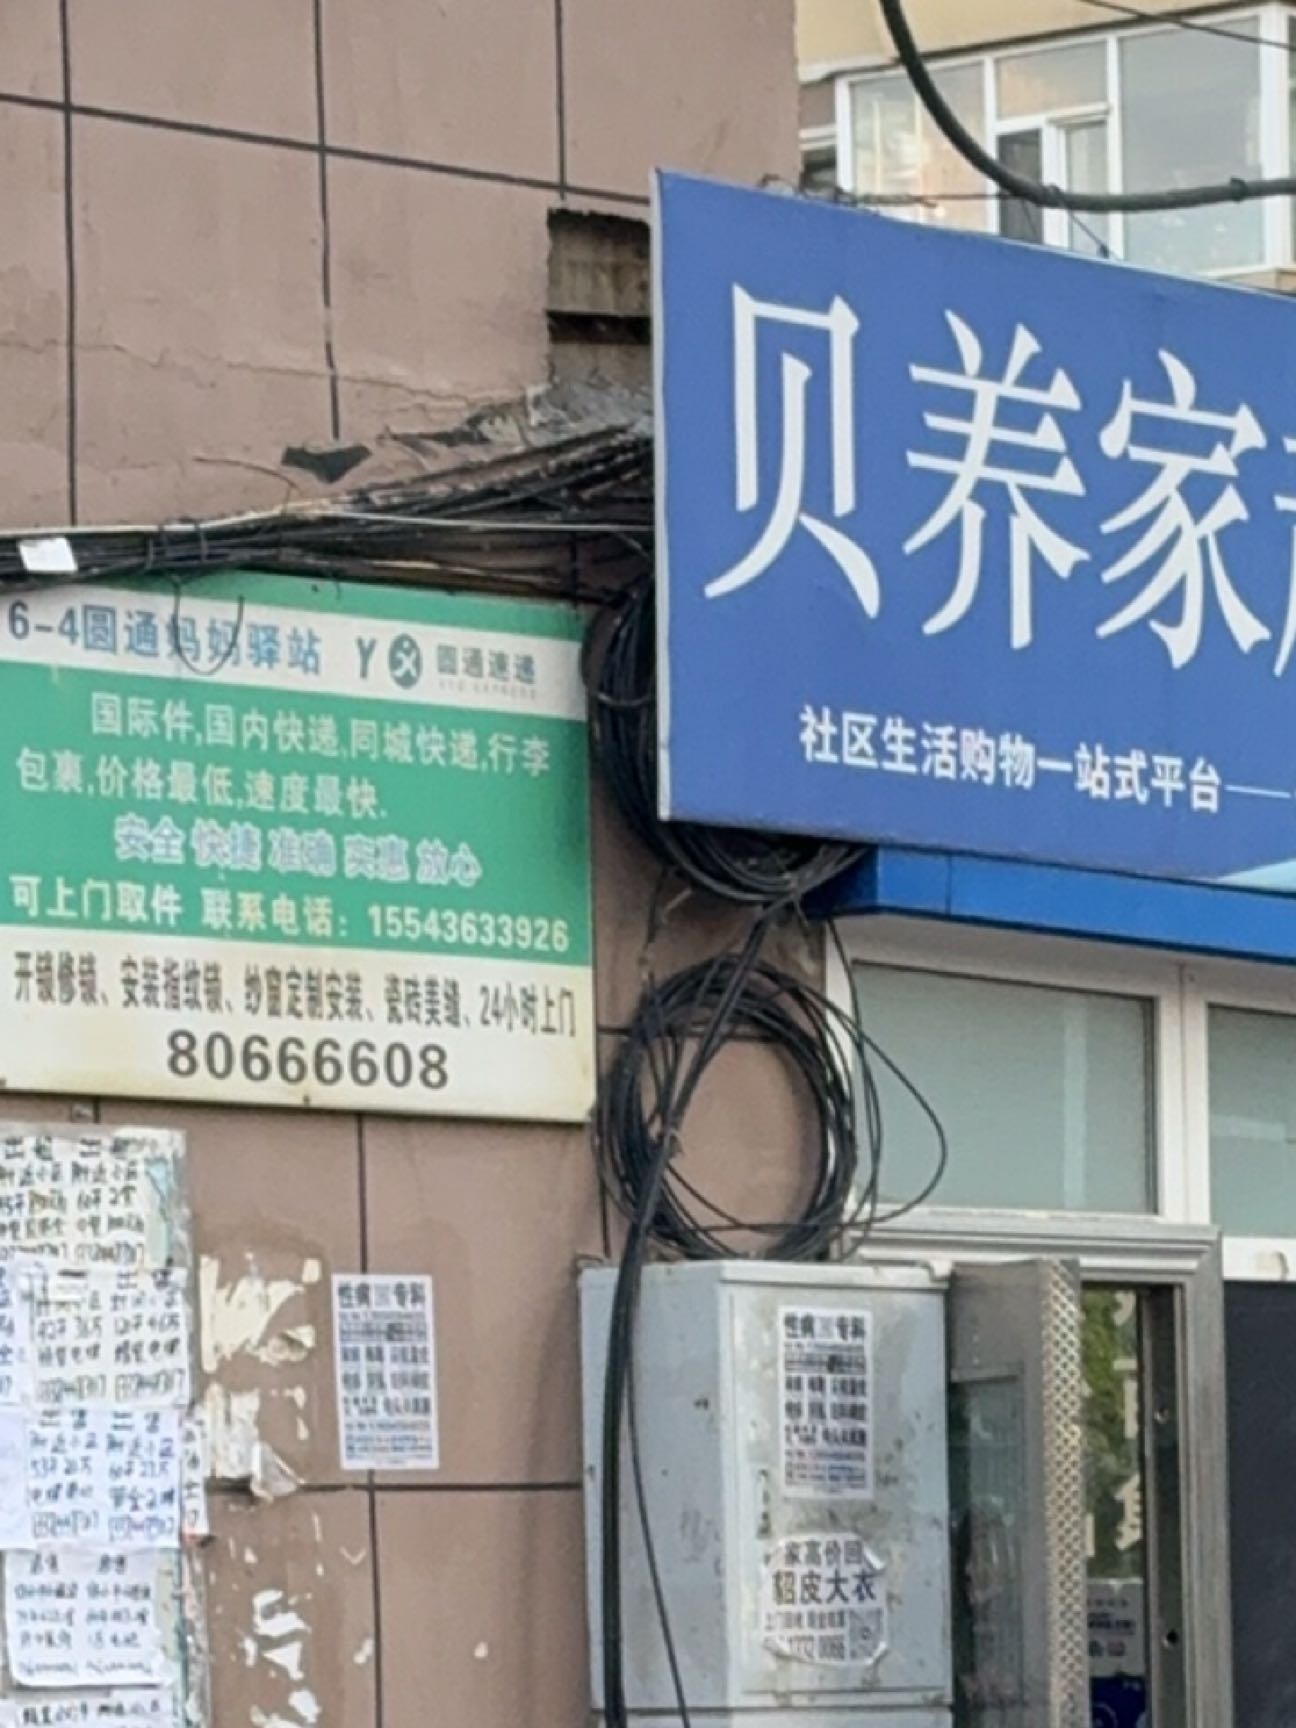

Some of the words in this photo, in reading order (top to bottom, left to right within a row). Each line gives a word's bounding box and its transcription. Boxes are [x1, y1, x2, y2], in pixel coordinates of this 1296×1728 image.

[115, 812, 185, 864] 安全
[9, 875, 183, 927] 可上门取件
[367, 904, 570, 953] 15543633926
[167, 1028, 449, 1091] 80666608
